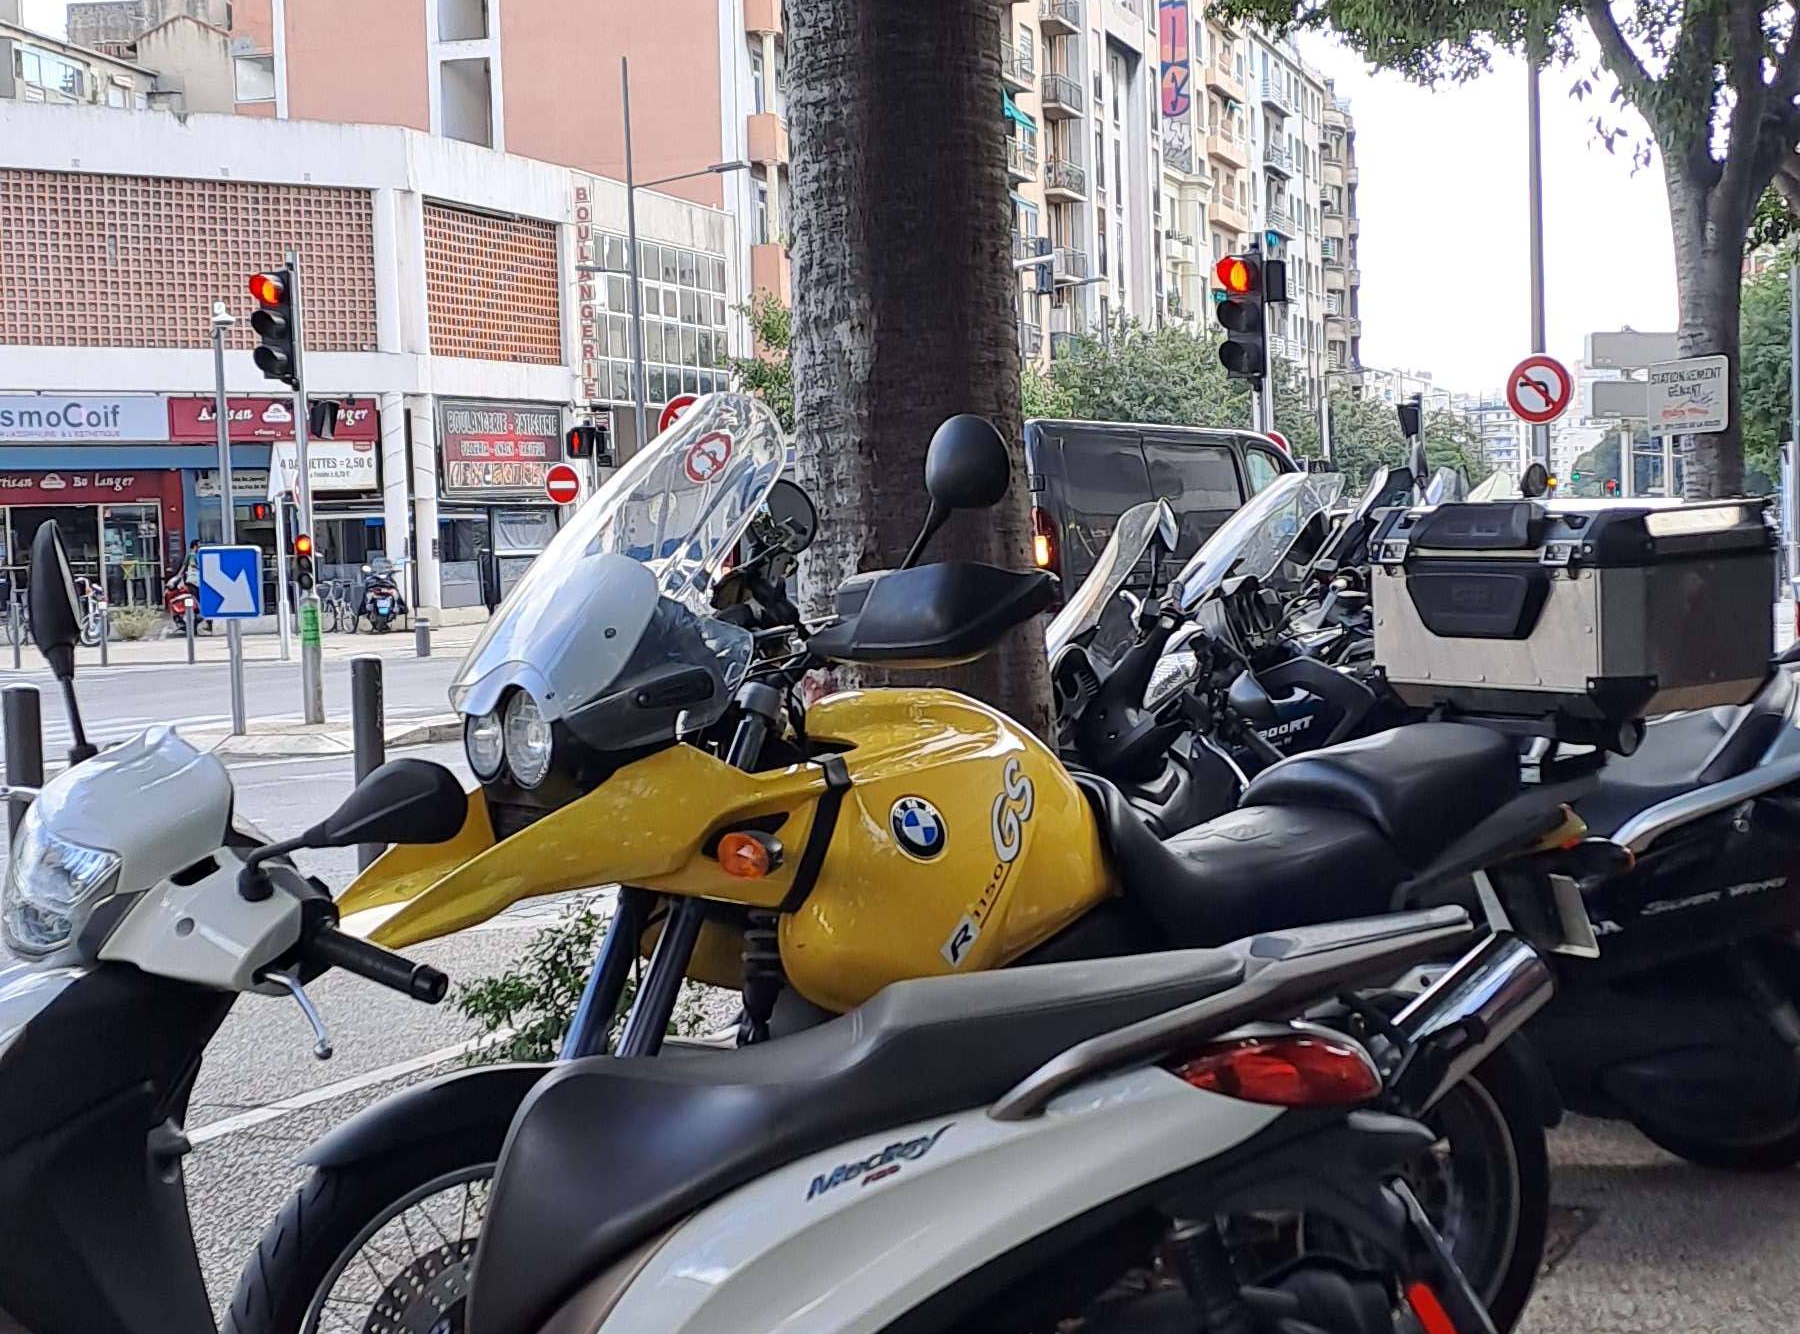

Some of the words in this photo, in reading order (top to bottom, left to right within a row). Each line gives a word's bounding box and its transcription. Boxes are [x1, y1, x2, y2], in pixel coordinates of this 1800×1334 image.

[574, 187, 596, 399] BOULANGERIE
[1256, 714, 1315, 740] 200RT
[894, 798, 937, 819] BMW
[991, 756, 1035, 863] GS
[949, 921, 974, 964] R
[972, 862, 1004, 920] 1150
